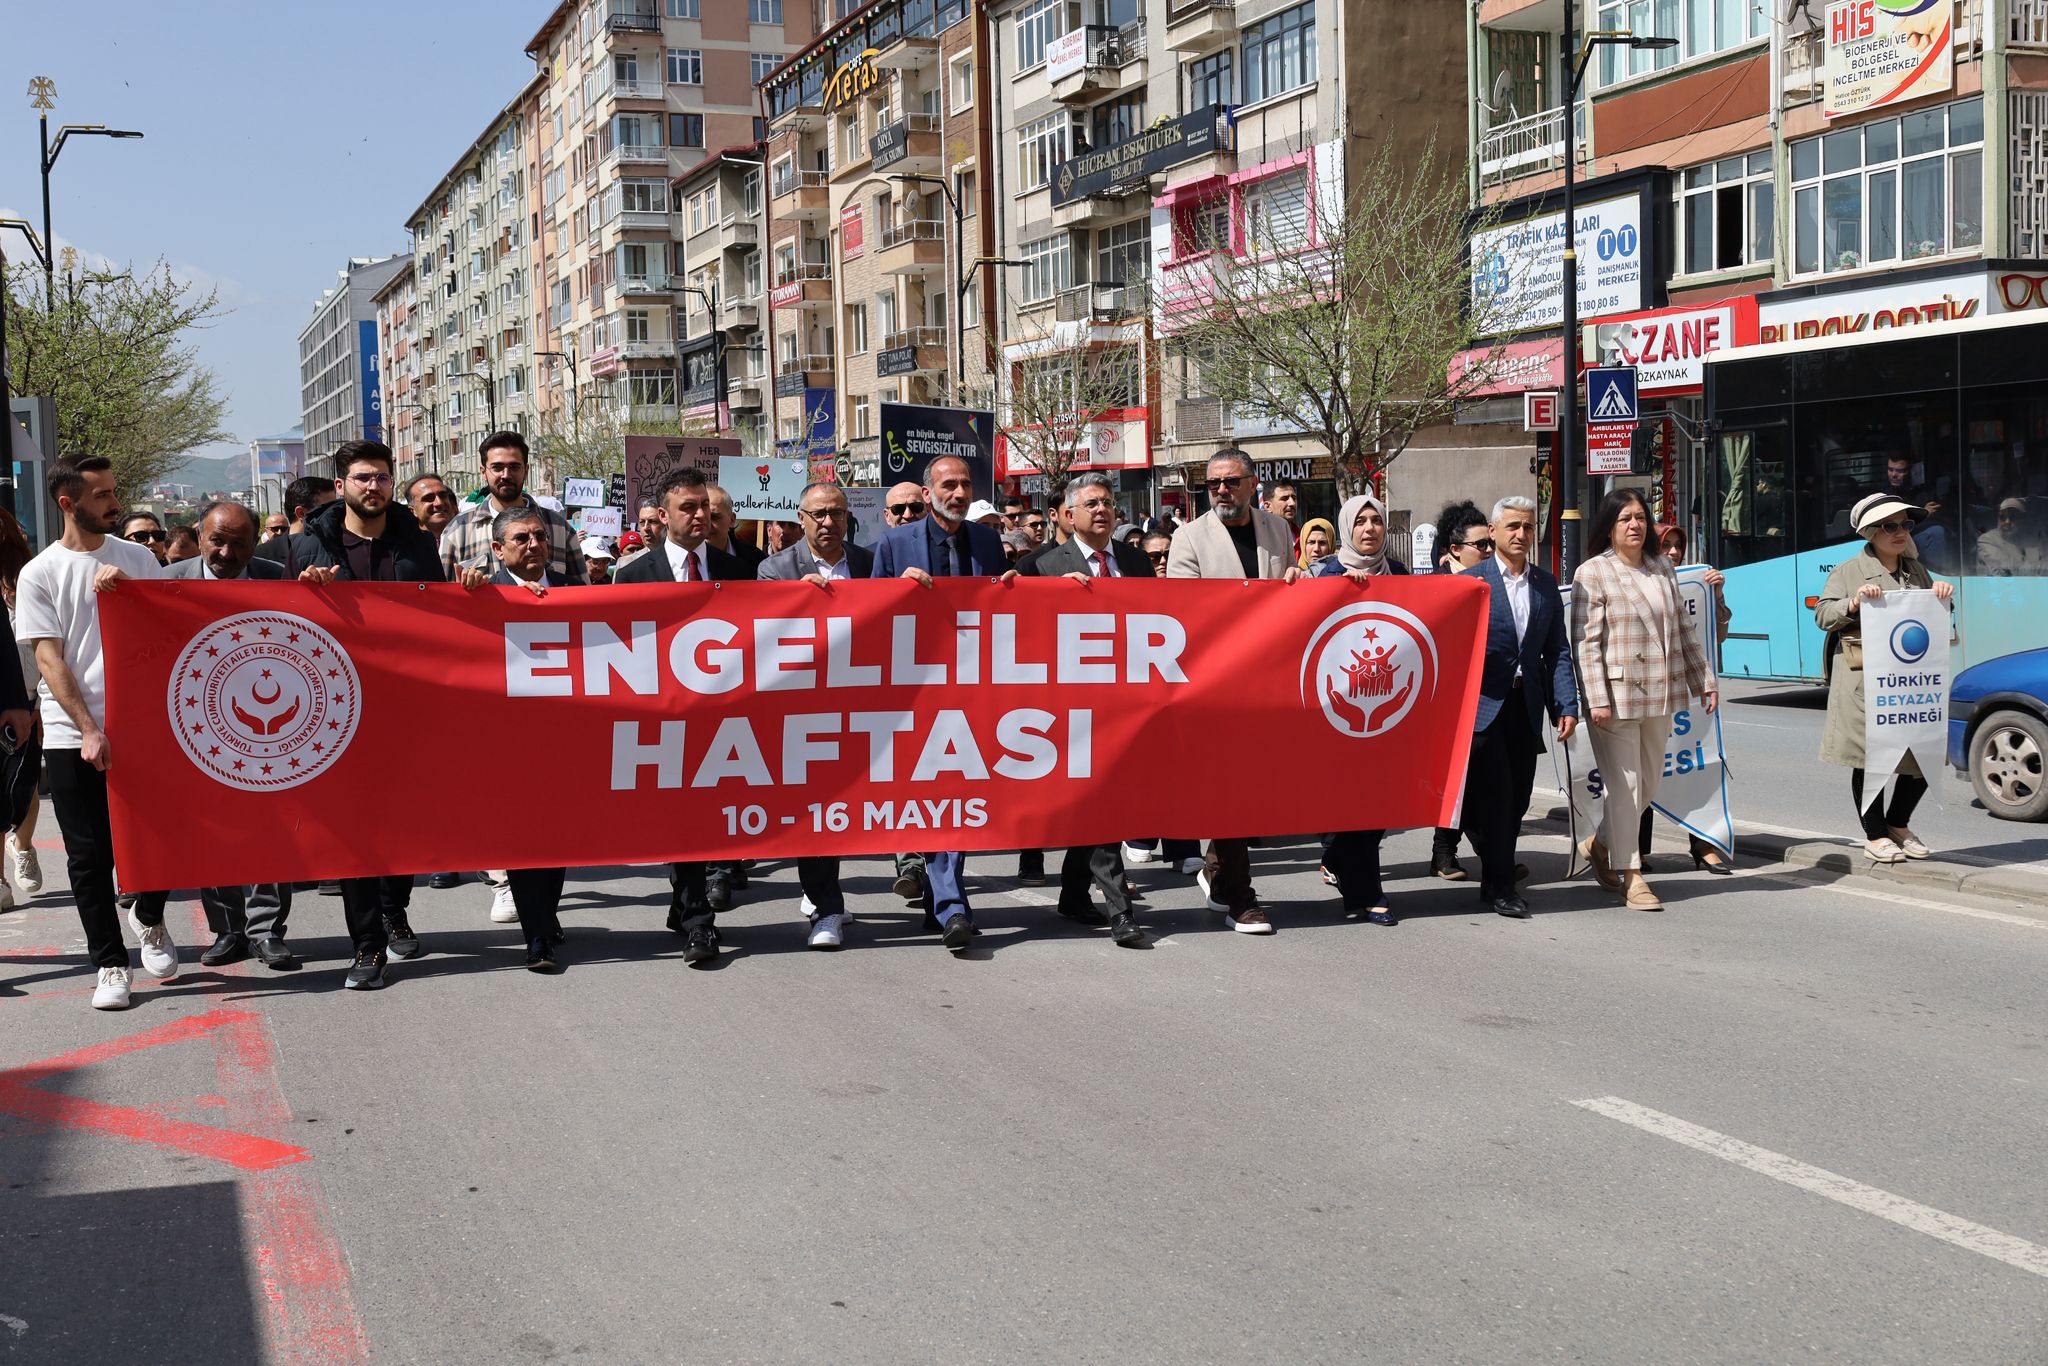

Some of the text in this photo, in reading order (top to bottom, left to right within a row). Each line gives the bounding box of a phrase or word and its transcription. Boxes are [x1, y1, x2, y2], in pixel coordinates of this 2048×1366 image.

[1832, 1, 1874, 45] HİS
[1845, 33, 1907, 58] BİOENERJİ VE
[849, 54, 862, 71] CAFE
[1851, 49, 1900, 69] BÖLGESEL
[1832, 55, 1919, 87] İNCELTME MERKEZİ
[1850, 86, 1871, 95] ÖZTÜRK
[877, 131, 894, 151] ARYA
[1077, 147, 1122, 178] HİCRAN
[1110, 158, 1145, 182] BEAUTY
[1506, 214, 1600, 249] TRAFİK KAZLARI
[1597, 260, 1639, 275] DANIŞMANLIK
[1597, 272, 1639, 288] MERKEZİ
[1526, 309, 1537, 320] 214
[1538, 307, 1547, 318] 78
[1548, 306, 1557, 317] 50
[1583, 300, 1596, 311] 180
[1597, 297, 1608, 308] 80
[1609, 295, 1619, 307] 85
[1622, 316, 1720, 364] CZANE
[1535, 400, 1550, 423] E
[916, 429, 935, 440] büyük
[937, 431, 955, 441] engel
[1604, 440, 1622, 448] HARİÇ
[699, 446, 720, 456] HER
[694, 458, 719, 469] İNSA
[1275, 459, 1312, 480] POLAT
[569, 486, 599, 497] AYNI
[587, 514, 616, 525] BÜYÜK
[1876, 672, 1941, 688] TÜRKİYE
[208, 646, 324, 753] TÜRKİYE CUMHURİYETİ AİLE VE SOSYAL HİZMETLER BAKANLIĞI
[1876, 692, 1942, 707] BEYAZAY
[1876, 708, 1942, 725] DERNEĞİ
[611, 707, 1093, 790] HAFTASI
[722, 804, 767, 836] 10
[811, 801, 850, 831] 16
[863, 797, 989, 831] MAYIS
